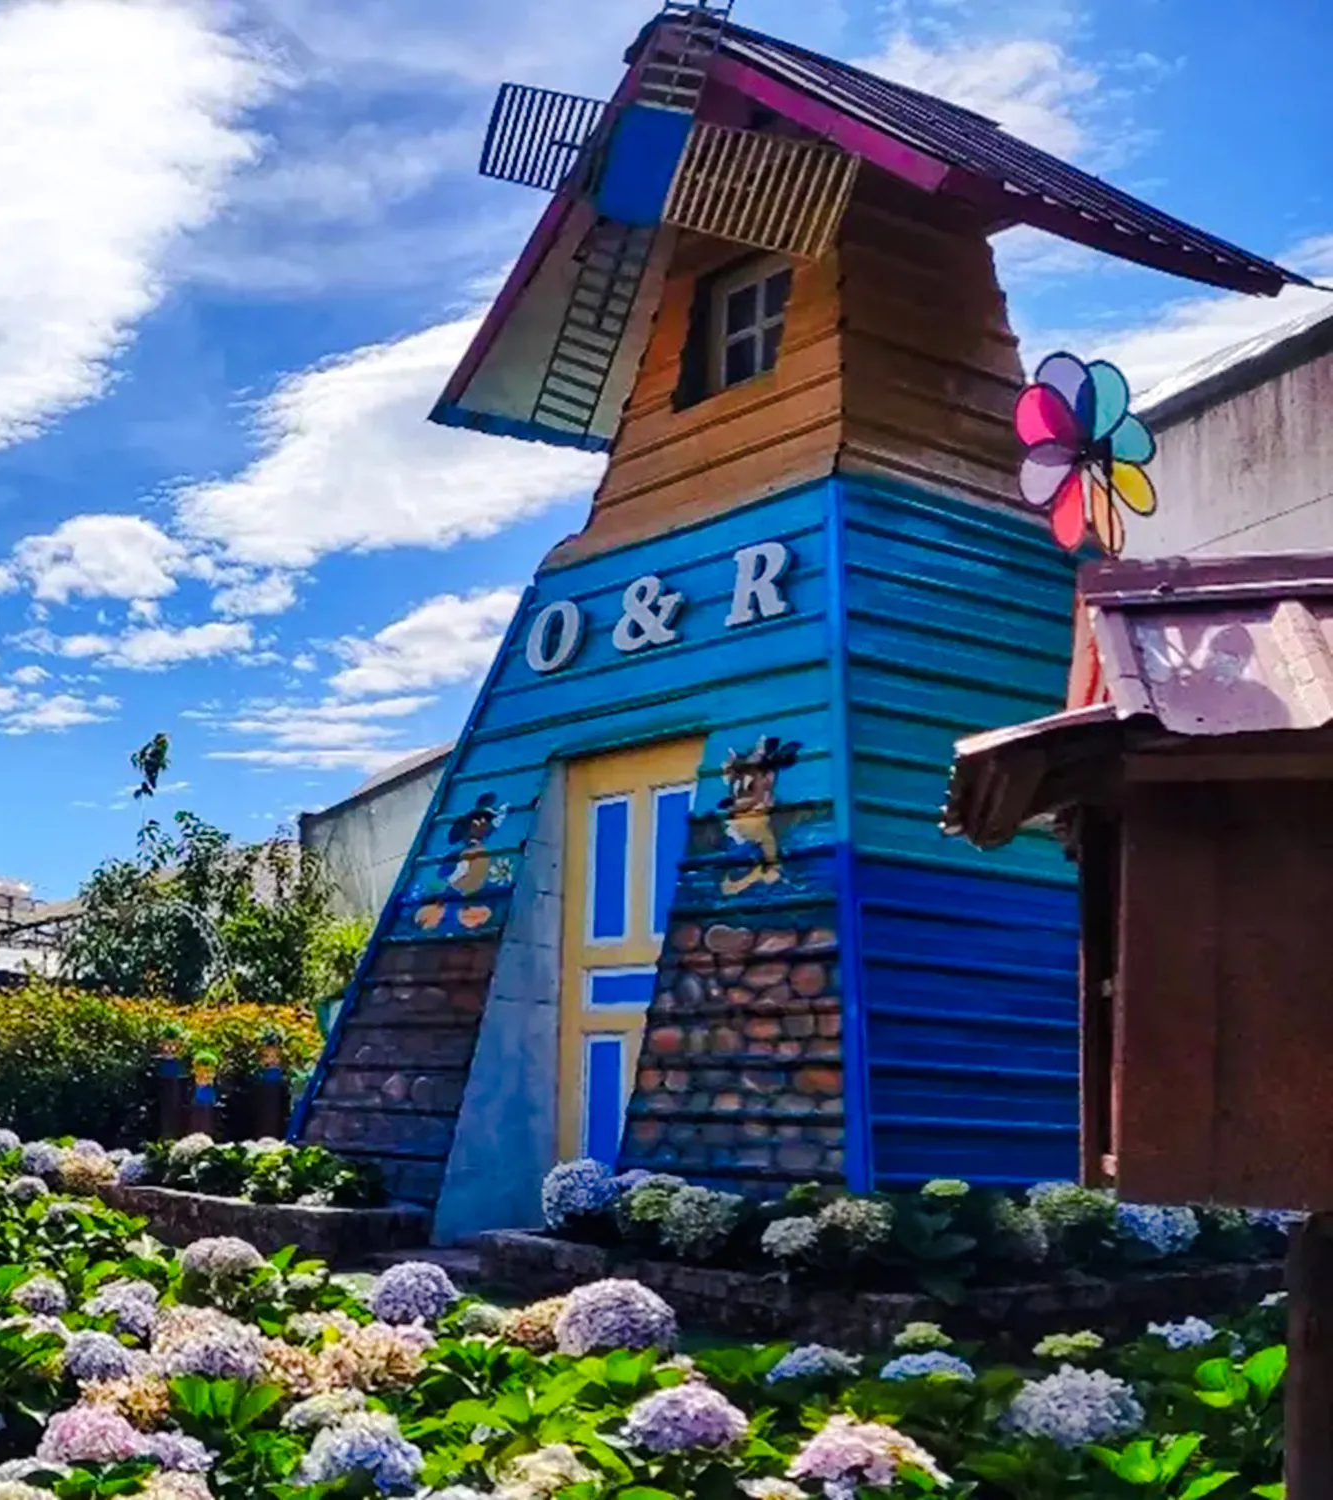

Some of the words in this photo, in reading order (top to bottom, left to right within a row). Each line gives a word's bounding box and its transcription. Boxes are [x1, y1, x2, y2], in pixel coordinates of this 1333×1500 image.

[525, 600, 583, 673] O
[612, 575, 683, 652] &
[724, 541, 791, 627] R
